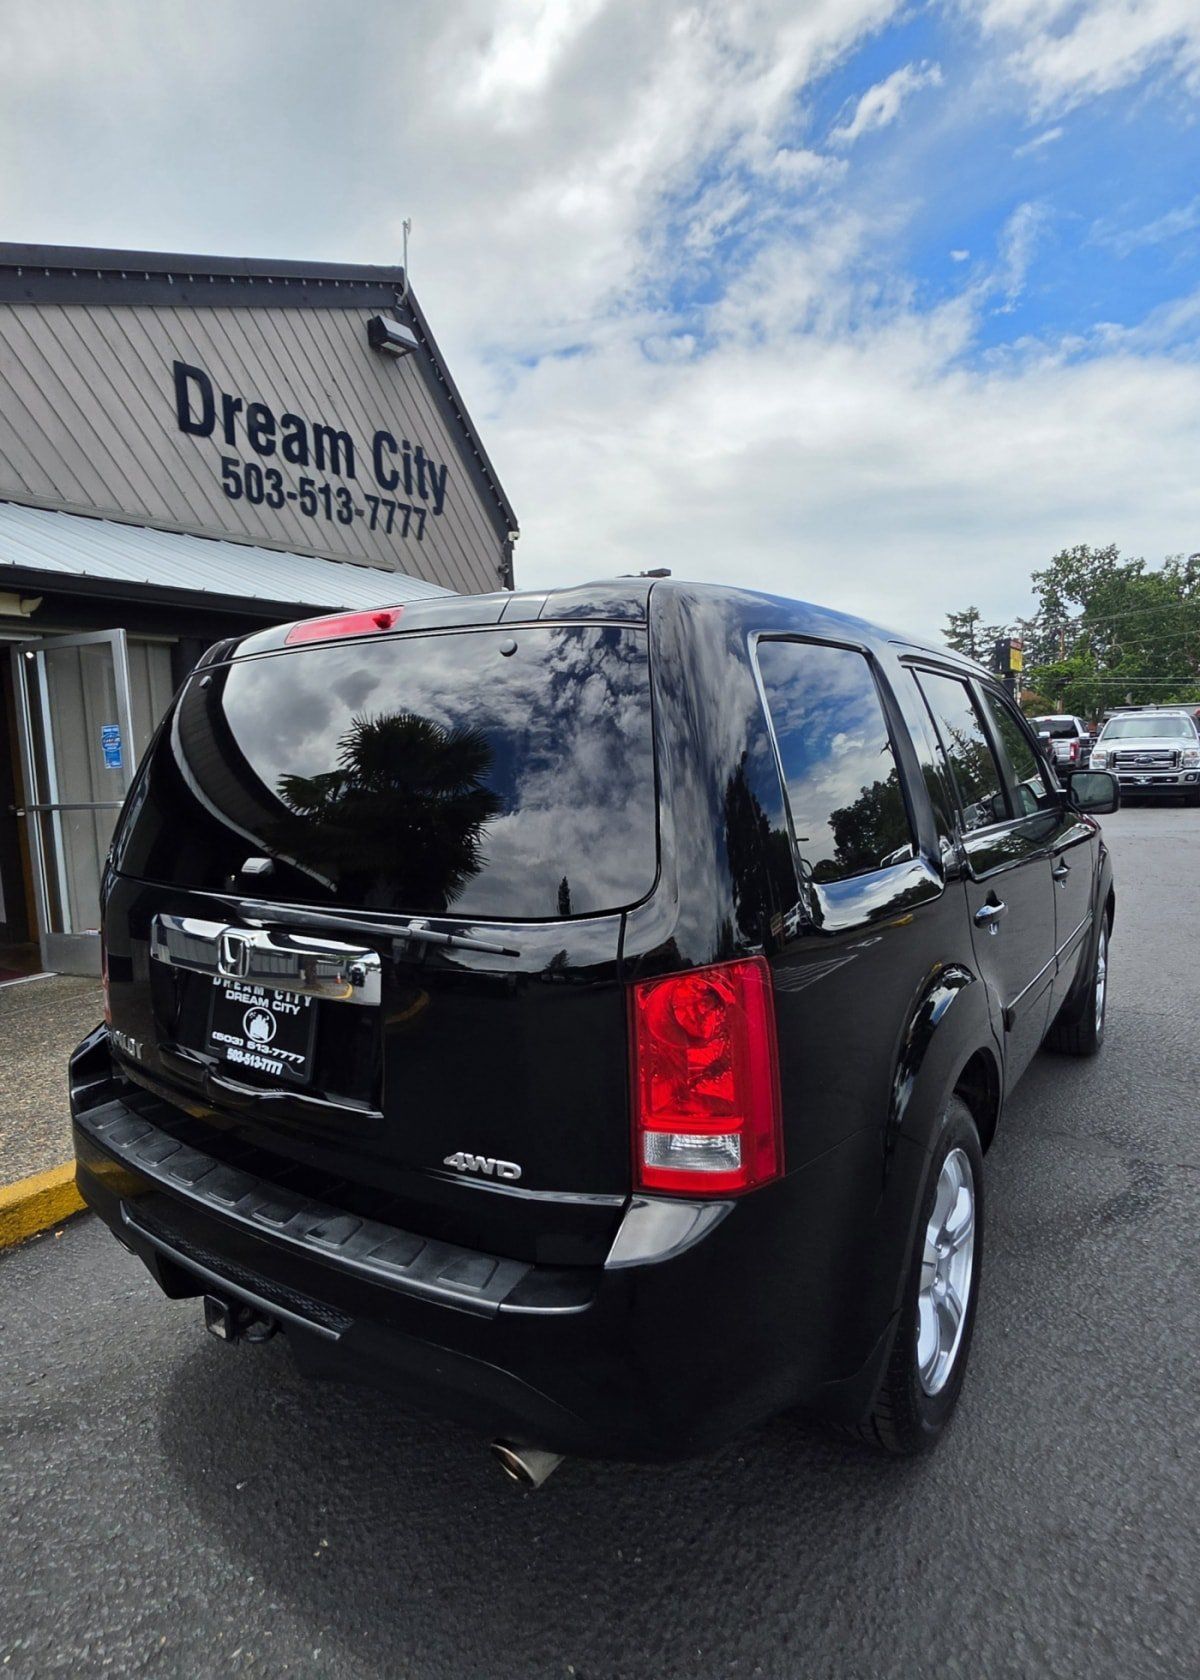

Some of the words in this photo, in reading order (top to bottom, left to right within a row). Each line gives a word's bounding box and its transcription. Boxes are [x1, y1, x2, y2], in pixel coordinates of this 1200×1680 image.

[173, 360, 355, 479] Dream
[373, 430, 447, 516] City
[221, 456, 427, 541] 503-513-7777
[225, 990, 269, 1008] DREAM
[272, 1001, 300, 1015] CITY
[212, 1031, 244, 1046] (503)
[247, 1041, 305, 1064] 513-7777
[443, 1152, 522, 1180] 4WD
